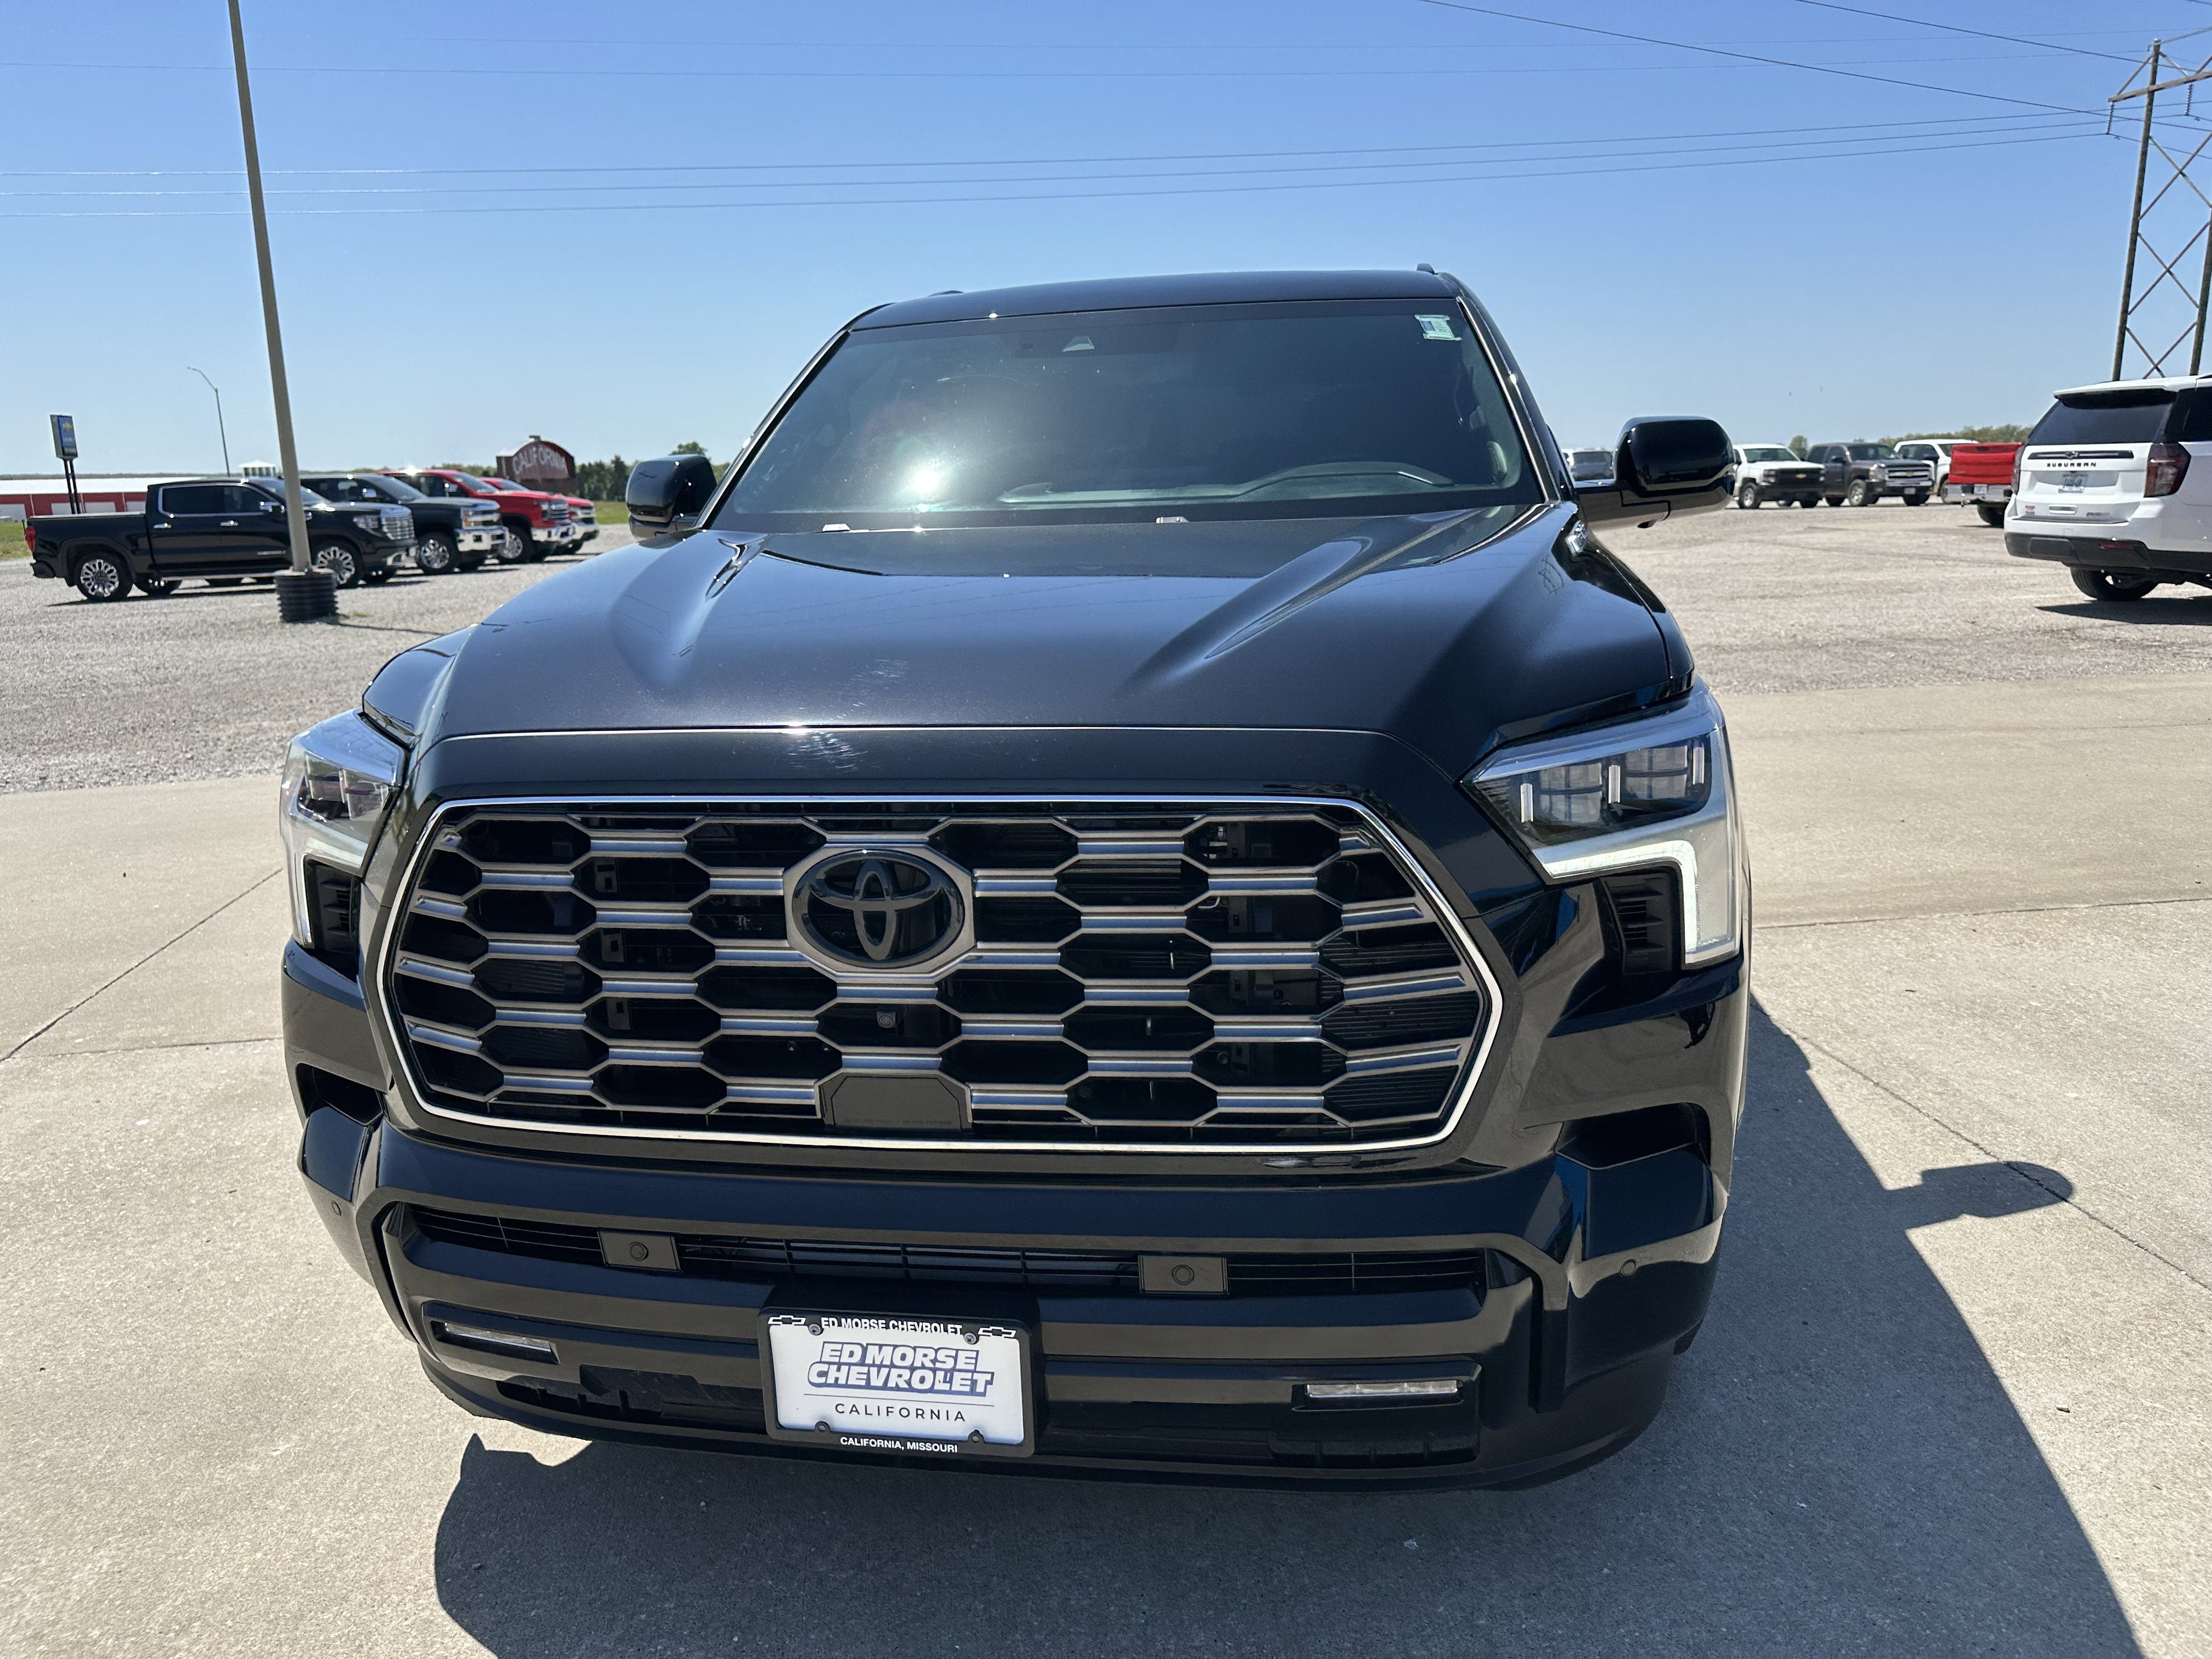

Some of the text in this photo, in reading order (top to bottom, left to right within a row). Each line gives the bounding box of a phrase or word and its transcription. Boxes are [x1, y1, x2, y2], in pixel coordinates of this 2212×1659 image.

[512, 445, 568, 475] CALIFORNIA
[821, 1317, 963, 1335] ED MORSE CHEVROLET
[808, 1341, 994, 1397] ED MORSE CHEVROLET
[835, 1403, 966, 1422] CALIFORNIA
[840, 1436, 958, 1453] CALIFORNIA, MISSOURI
